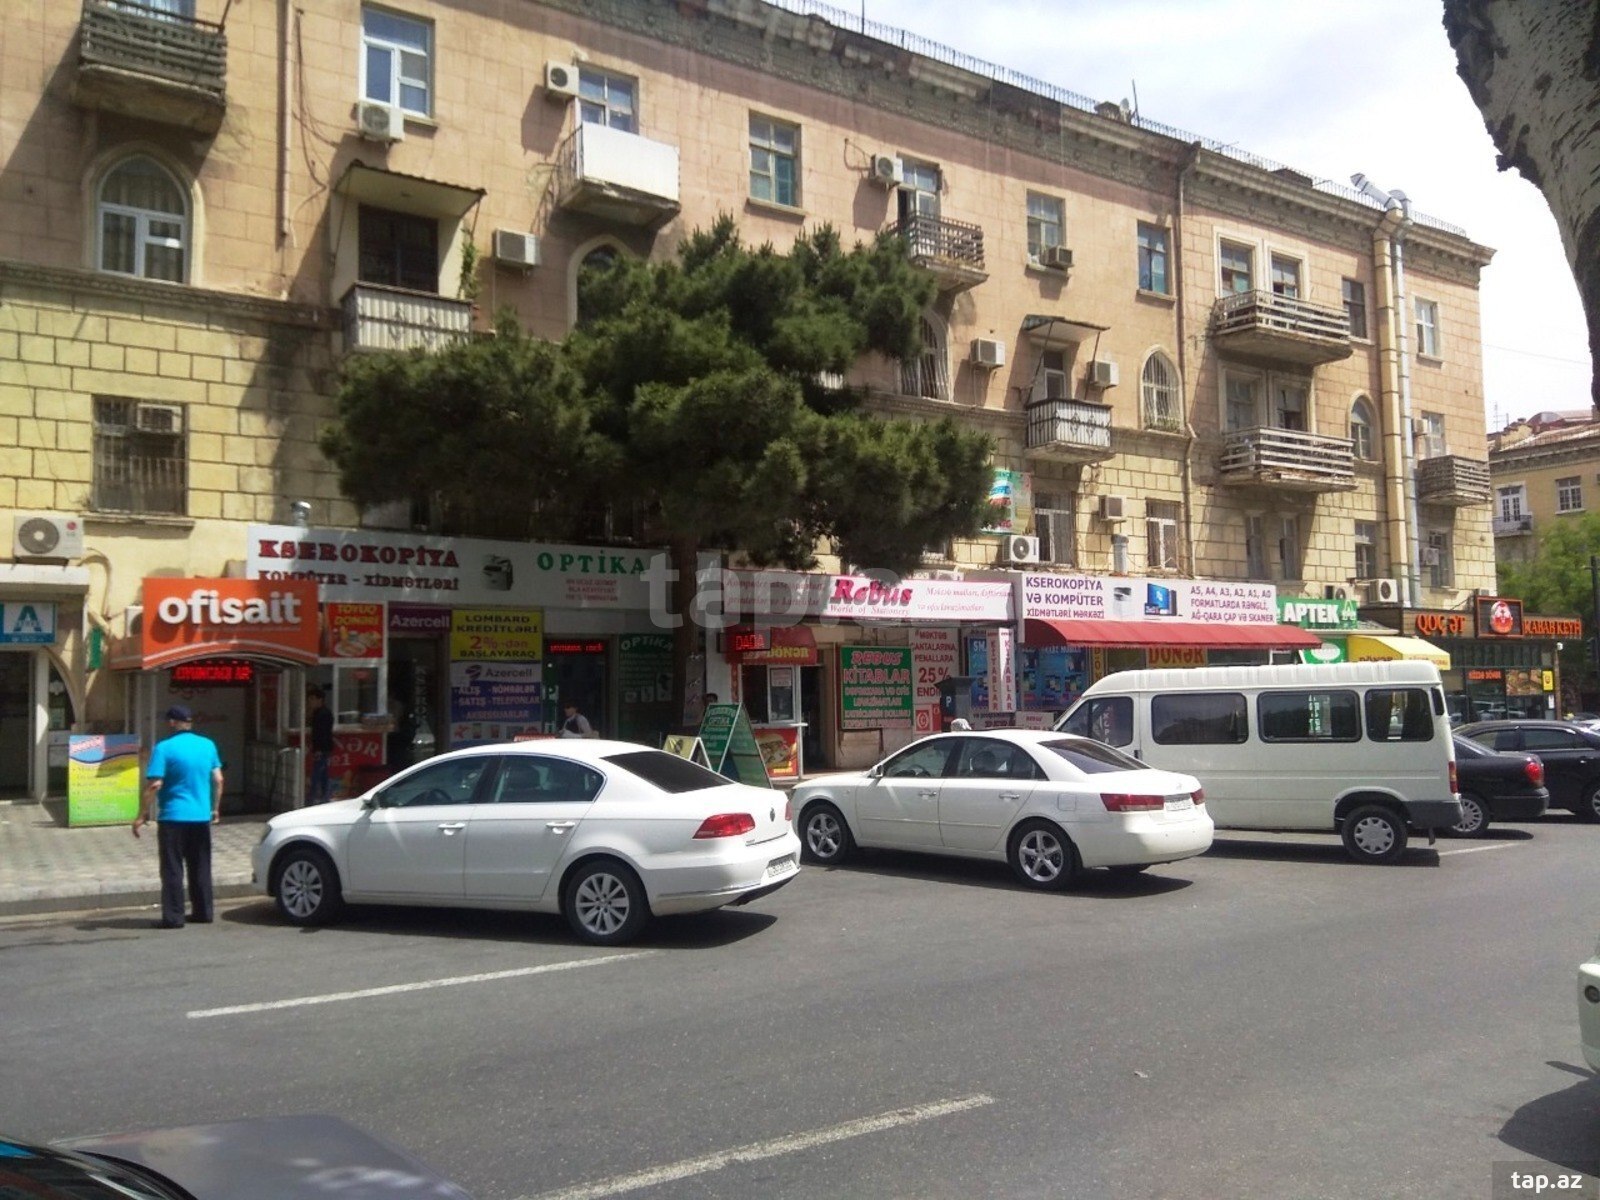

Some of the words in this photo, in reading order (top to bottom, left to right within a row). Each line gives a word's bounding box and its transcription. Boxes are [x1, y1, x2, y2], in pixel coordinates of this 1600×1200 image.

[258, 539, 460, 568] KSEROKOPİYA
[537, 549, 646, 574] OPTİKA
[364, 572, 460, 591] XİDMƏTLƏRİ
[1025, 576, 1103, 591] KSEROKOPİYA
[831, 579, 914, 607] Rebus
[1190, 585, 1204, 597] A5,
[1205, 586, 1218, 597] A4,
[1219, 588, 1233, 598] A3,
[157, 588, 302, 625] ofisait
[1026, 593, 1042, 604] VƏ
[1045, 593, 1104, 606] KOMPÜTER
[1190, 598, 1241, 610] FORMATLARDA
[465, 615, 530, 623] LOMBARD
[1026, 607, 1072, 619] XİDMƏTLƏRİ
[1073, 608, 1105, 620] MƏRKƏZİ
[1191, 611, 1222, 623] AĞ-QARA
[1223, 612, 1237, 624] ÇAP
[1238, 613, 1248, 622] VƏ
[1248, 613, 1274, 623] SKANER
[1283, 602, 1340, 624] APTEK
[391, 615, 450, 628] Azercell
[1415, 613, 1448, 636] QOÇ
[1449, 615, 1466, 633] ƏT
[1524, 618, 1556, 634] KABAB
[457, 625, 539, 634] KREDİTLƏRİ
[485, 669, 533, 678] Azercell
